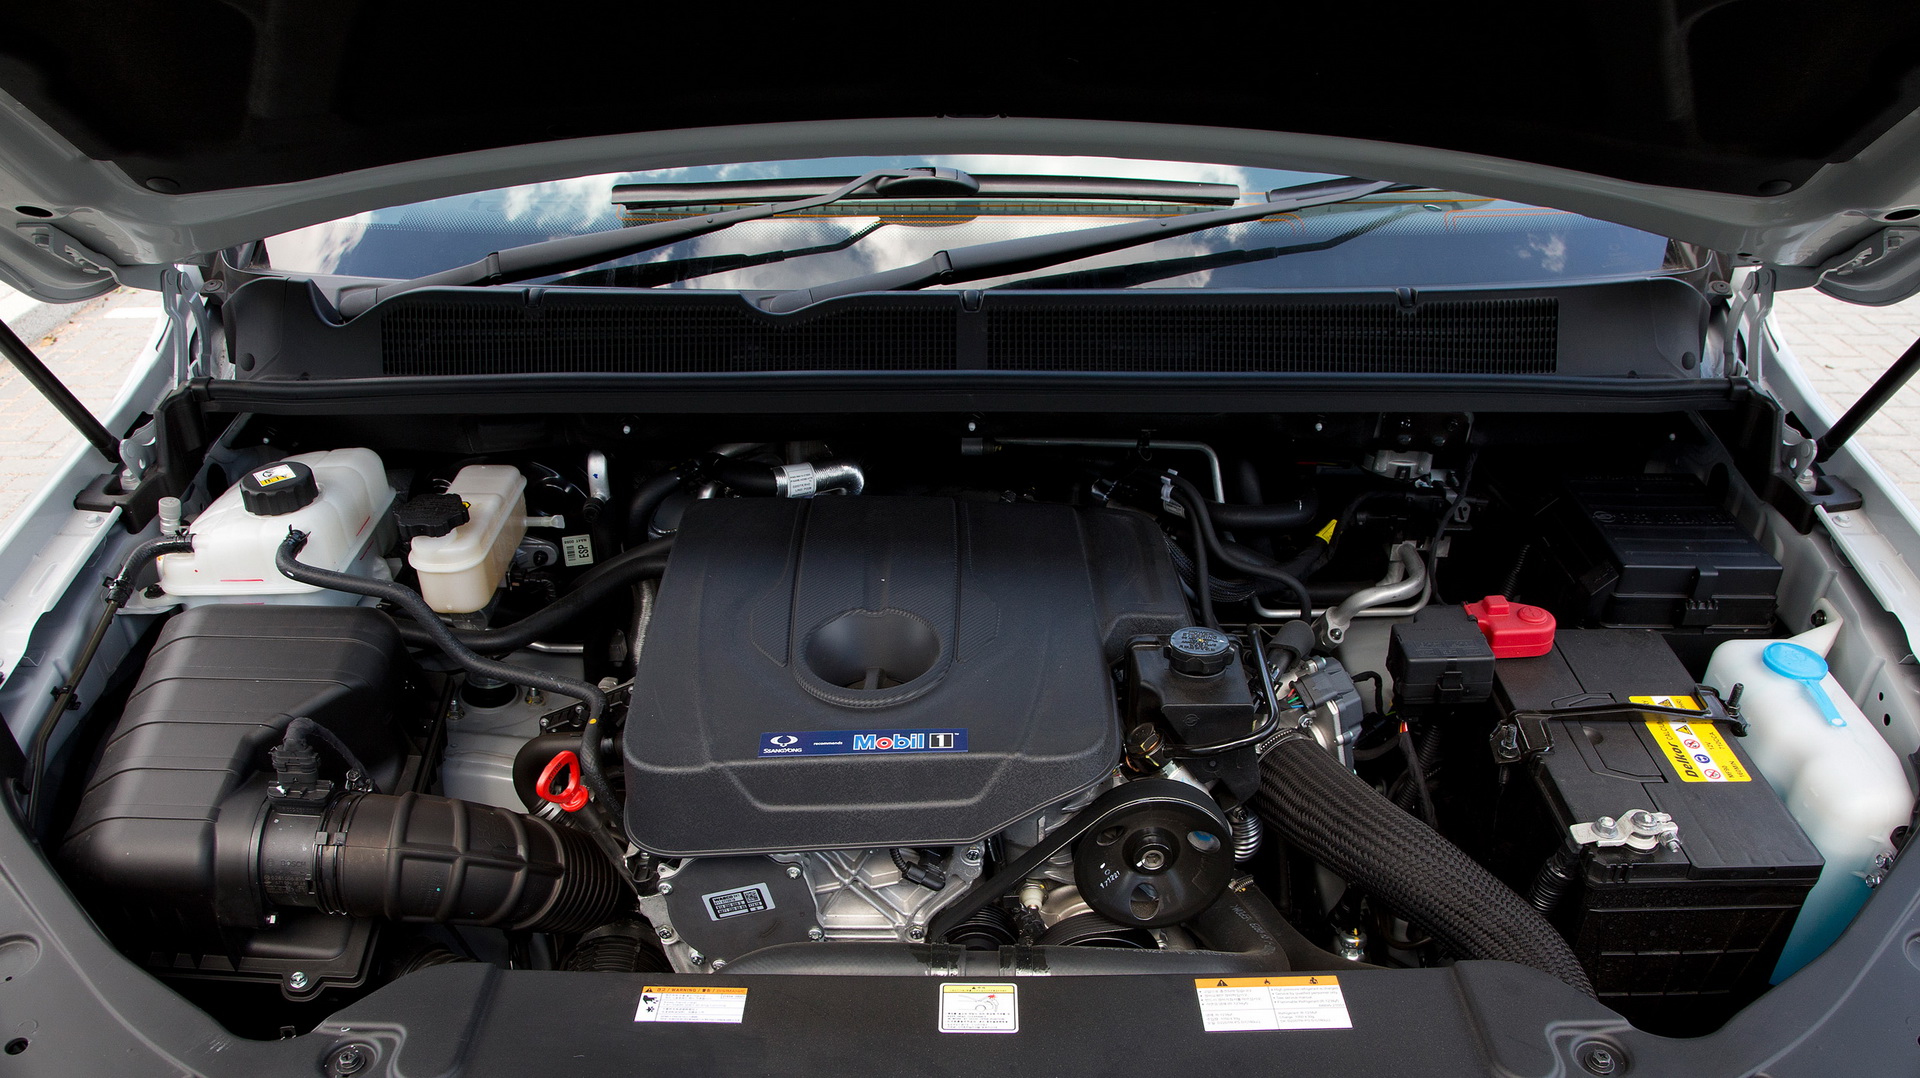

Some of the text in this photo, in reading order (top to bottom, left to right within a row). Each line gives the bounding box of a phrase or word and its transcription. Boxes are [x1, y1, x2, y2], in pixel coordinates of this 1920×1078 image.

[577, 544, 589, 558] ESP
[853, 733, 925, 750] Mobil
[1668, 741, 1698, 778] Delkor
[280, 860, 306, 868] BOSCH
